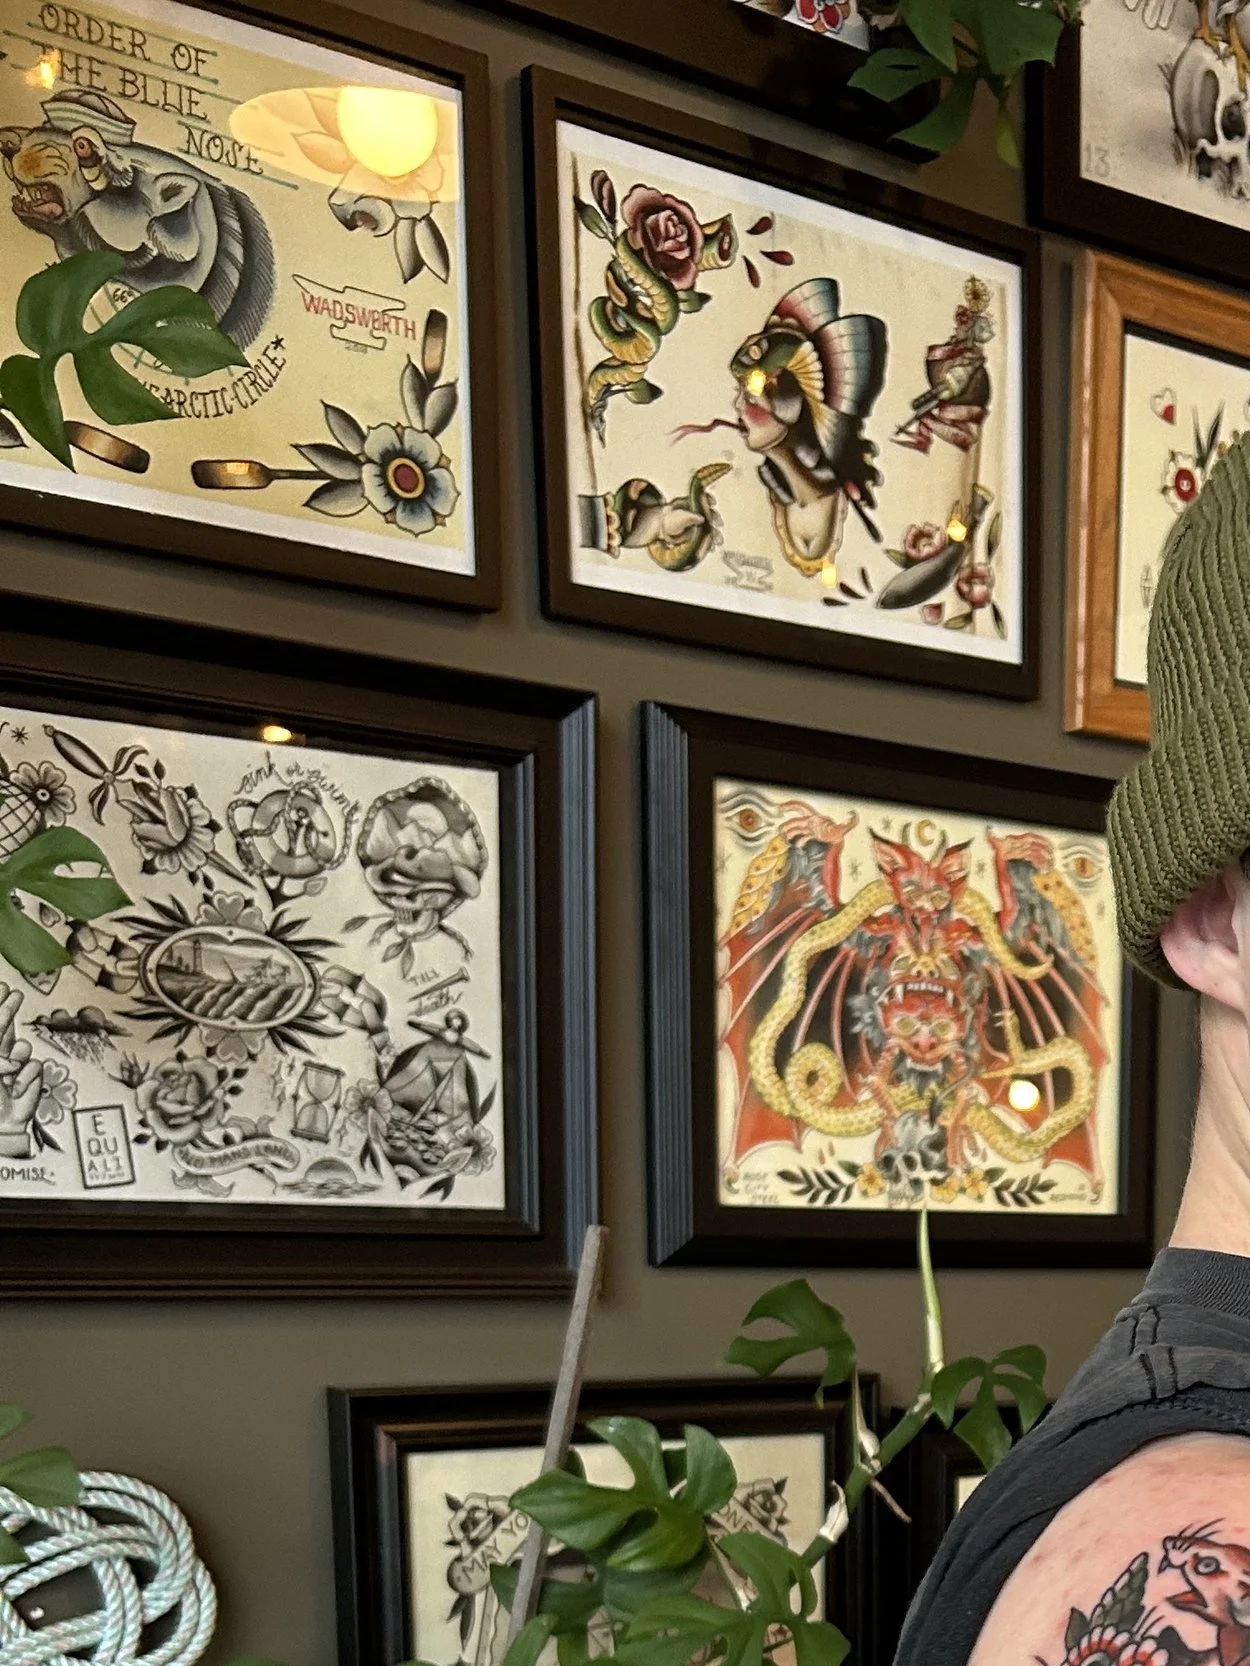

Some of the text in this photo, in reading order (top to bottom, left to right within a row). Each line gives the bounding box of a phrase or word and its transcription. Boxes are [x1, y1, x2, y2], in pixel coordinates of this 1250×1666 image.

[39, 3, 208, 77] ORDER OF
[118, 65, 208, 121] BLUE
[184, 125, 264, 176] NOSE
[1084, 143, 1111, 178] 13
[300, 289, 417, 341] WADSWORTH
[91, 1113, 106, 1136] E
[87, 1136, 118, 1157] QU
[501, 1512, 530, 1537] YO
